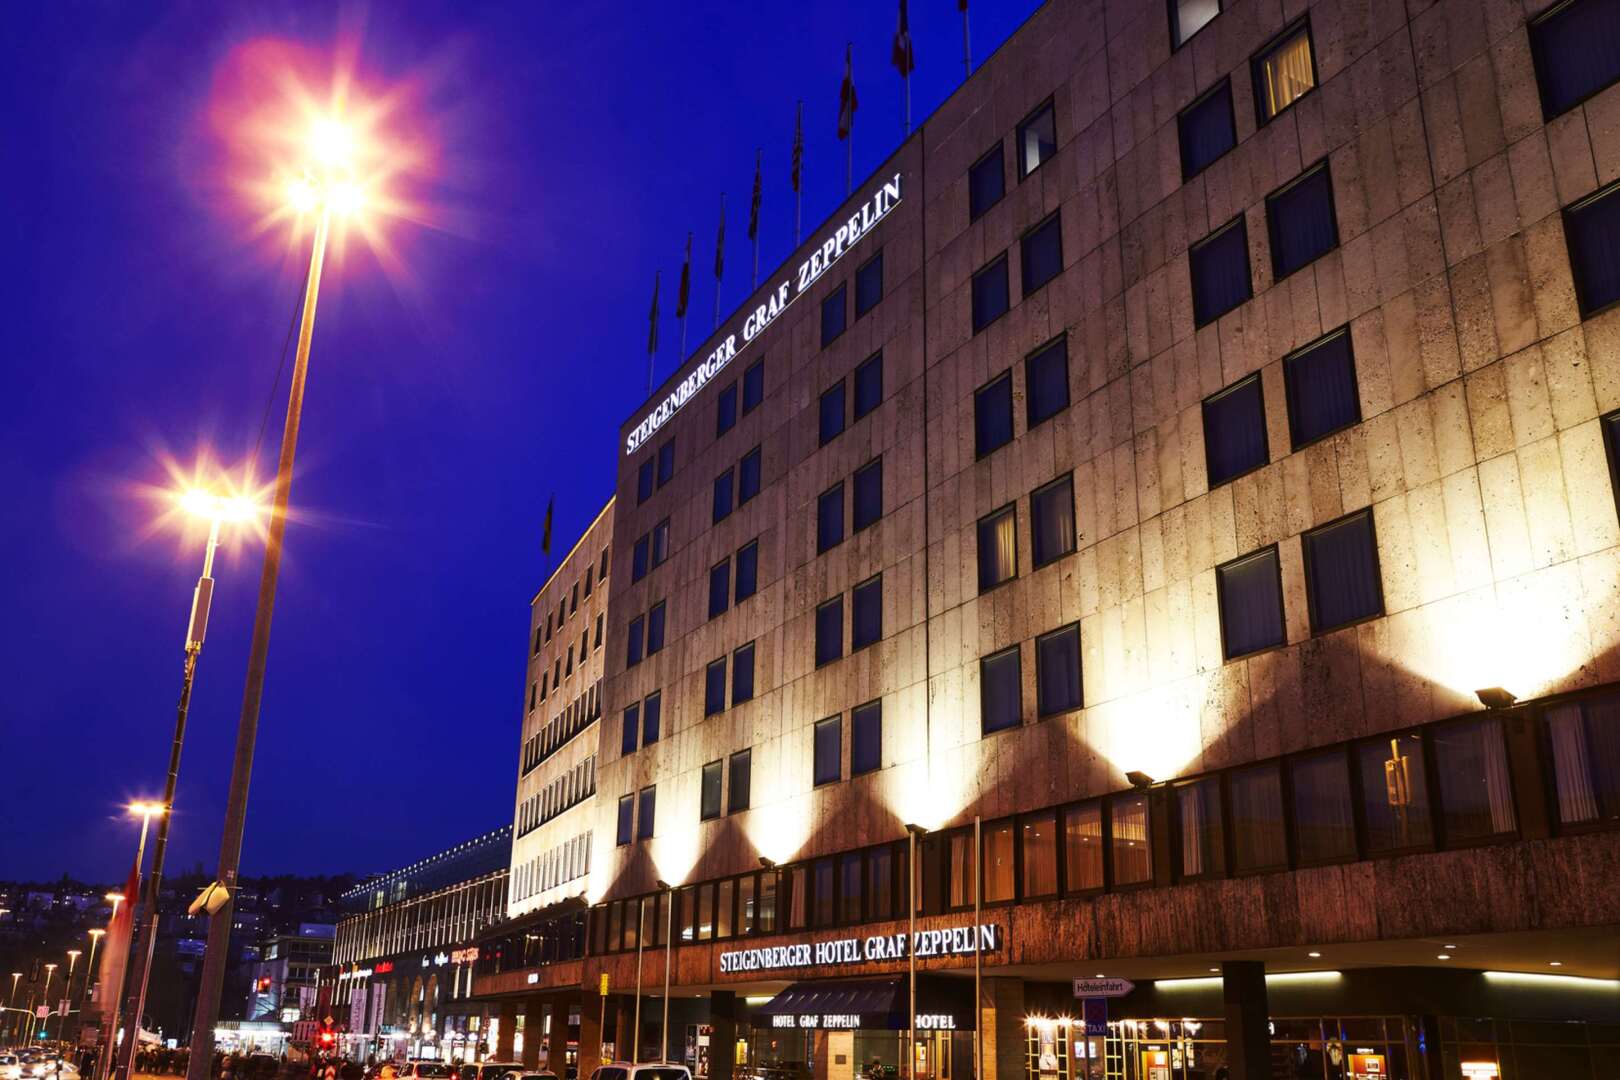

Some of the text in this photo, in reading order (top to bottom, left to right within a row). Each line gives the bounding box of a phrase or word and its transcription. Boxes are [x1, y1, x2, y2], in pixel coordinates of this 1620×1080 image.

[627, 173, 902, 455] STEIGENBERGER GRAF ZEPPELIN
[719, 943, 811, 972] STEIGENBERGER
[815, 939, 861, 964] HOTEL
[864, 934, 906, 960] GRAF
[773, 1014, 860, 1028] HOTEL GRAF ZEPPELIN
[1087, 1024, 1106, 1033] TAXI
